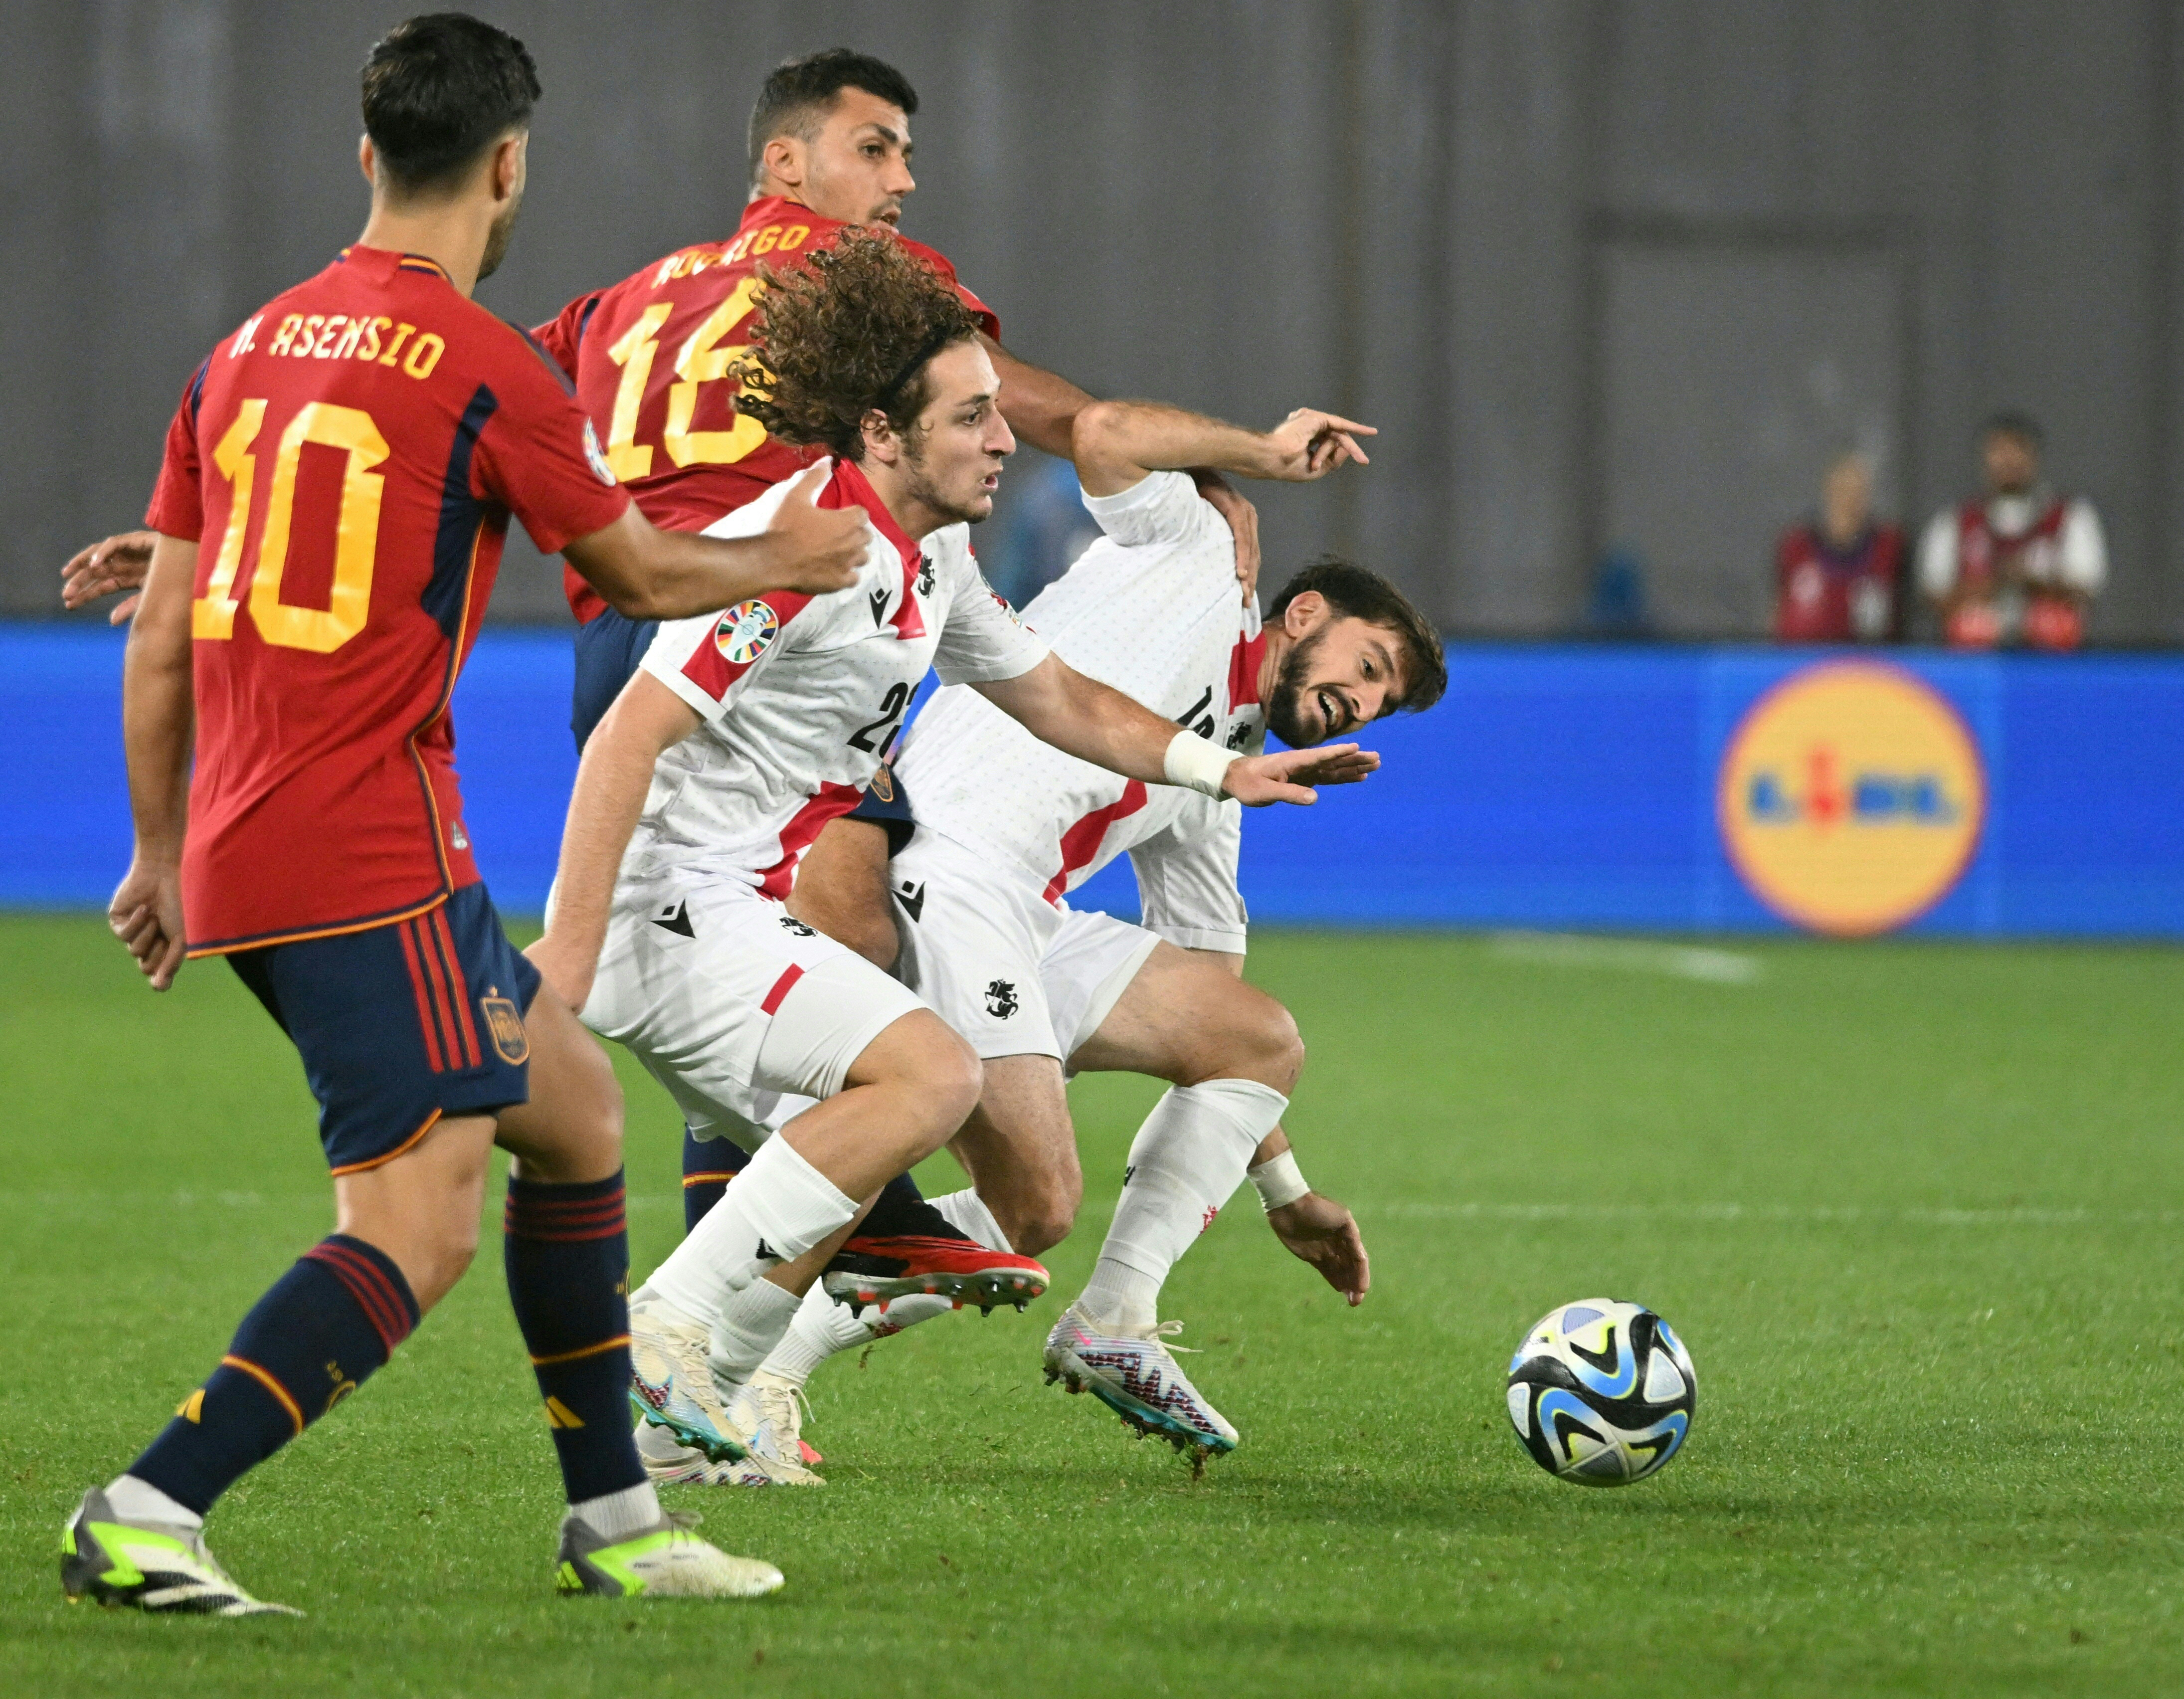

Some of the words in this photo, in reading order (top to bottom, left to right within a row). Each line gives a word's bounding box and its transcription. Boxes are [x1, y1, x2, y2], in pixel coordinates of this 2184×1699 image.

[269, 313, 445, 379] ASENSIO
[602, 277, 777, 483] 16
[192, 399, 390, 653] 10
